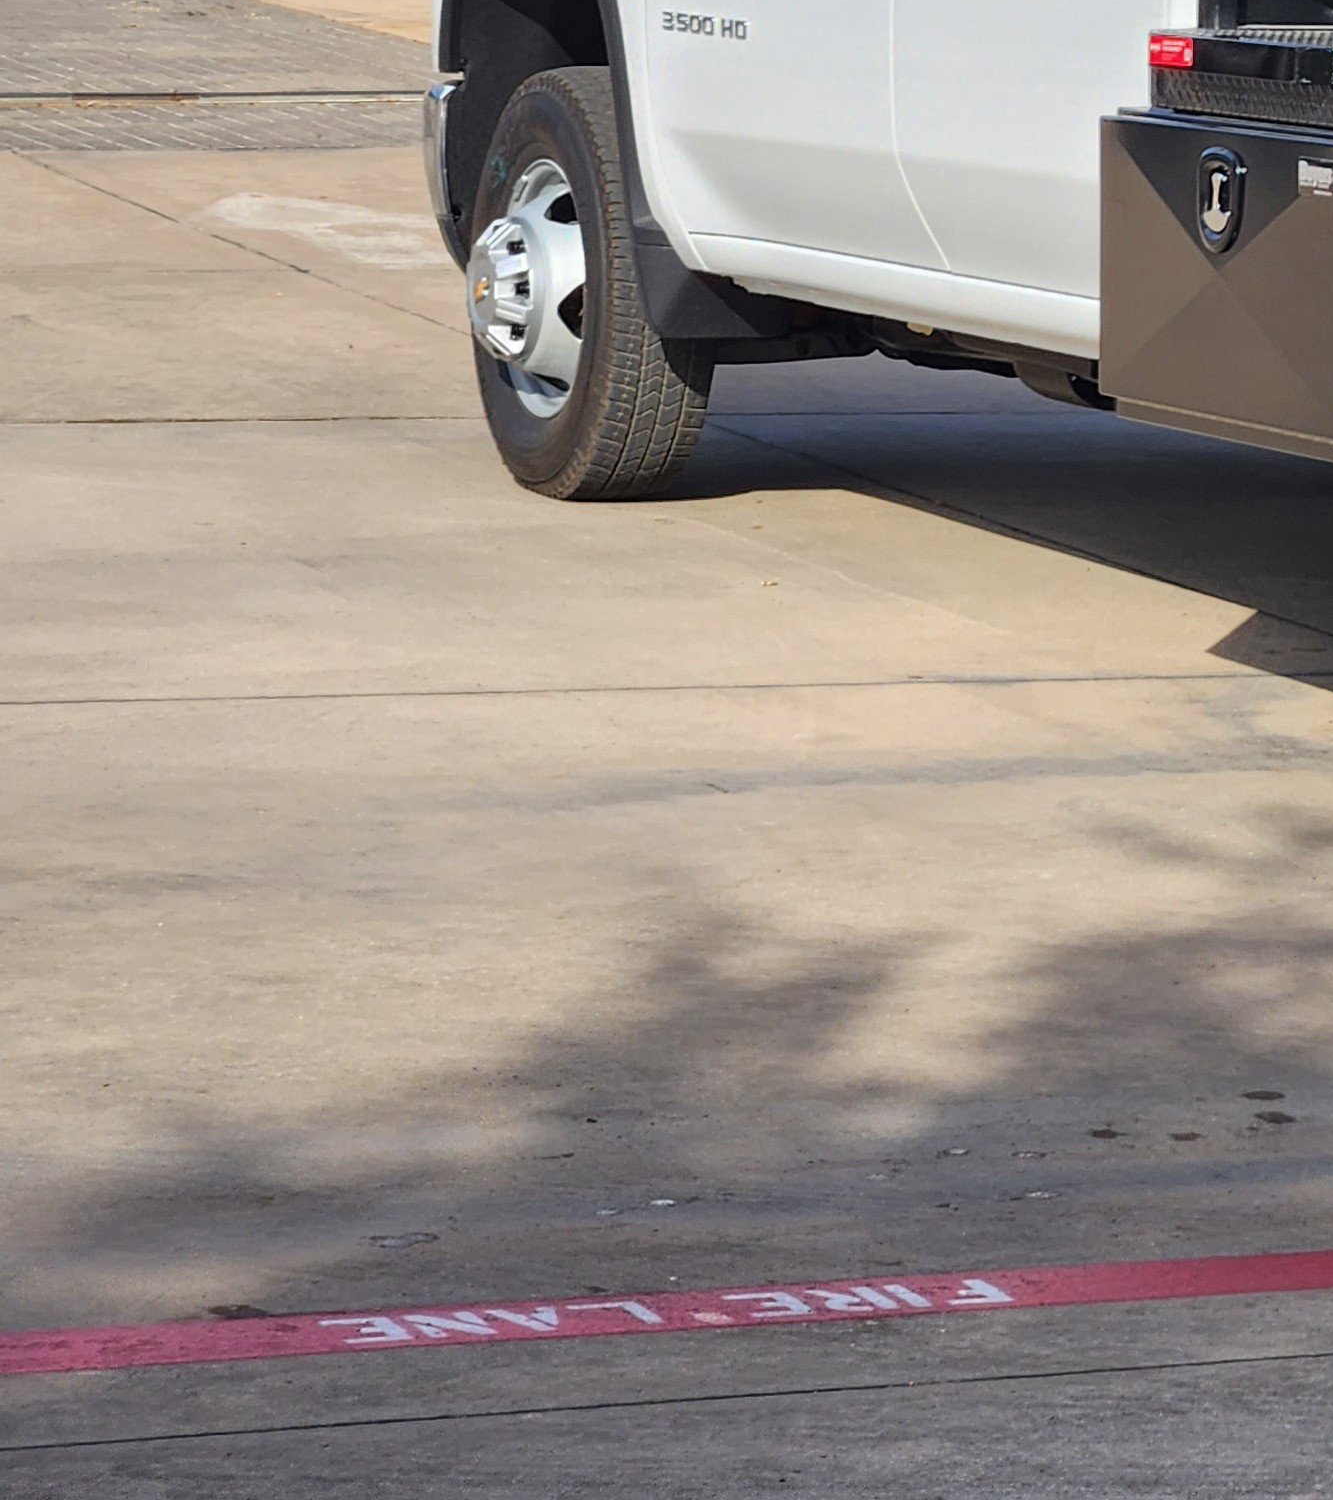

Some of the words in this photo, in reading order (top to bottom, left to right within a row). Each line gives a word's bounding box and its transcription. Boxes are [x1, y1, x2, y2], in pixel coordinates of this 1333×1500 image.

[662, 11, 715, 36] 3500
[721, 18, 747, 41] HD
[722, 1279, 1014, 1318] FIRE
[318, 1300, 664, 1344] LANE
